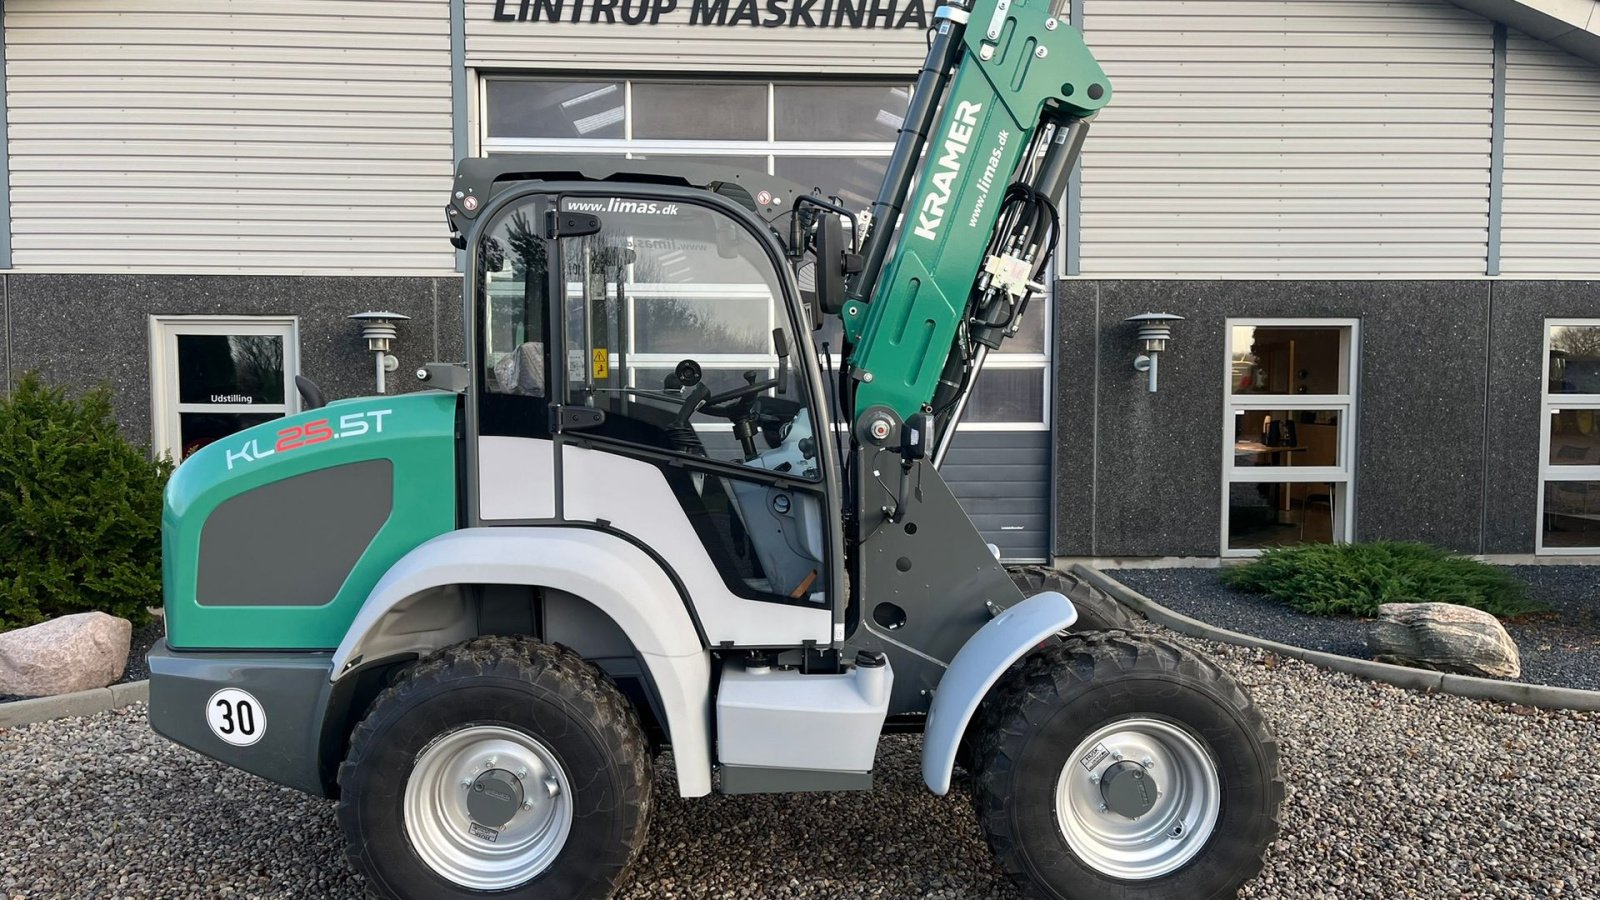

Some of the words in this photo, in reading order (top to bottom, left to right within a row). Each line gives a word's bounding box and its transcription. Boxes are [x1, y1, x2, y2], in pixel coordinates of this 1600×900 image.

[494, 0, 678, 26] LINTRUP
[914, 100, 983, 241] KRAMER
[968, 129, 1010, 228] www.limas.dk
[568, 198, 679, 216] www.limas.dk
[211, 394, 253, 404] Udstilling
[226, 409, 393, 470] KL25.5T
[216, 699, 255, 736] 30
